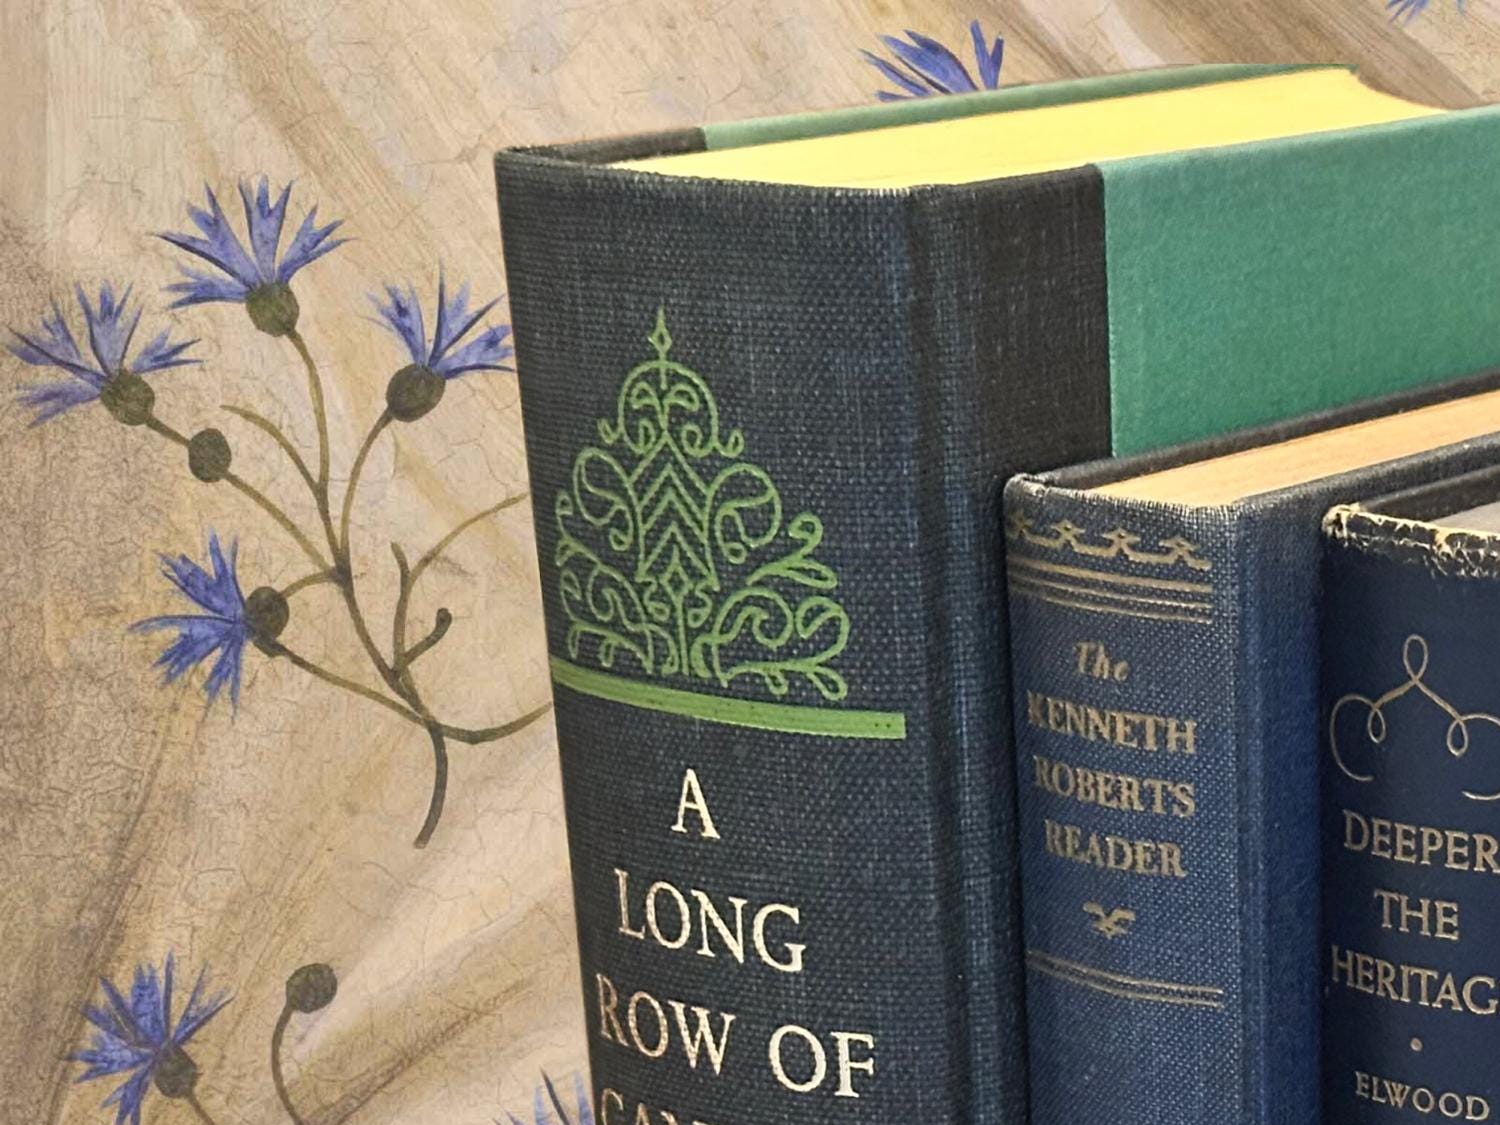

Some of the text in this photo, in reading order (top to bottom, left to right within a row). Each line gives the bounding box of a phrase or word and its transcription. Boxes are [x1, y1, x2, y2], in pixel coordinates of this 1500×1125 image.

[1073, 641, 1131, 682] The
[1027, 689, 1197, 754] KENNETH
[671, 768, 720, 839] A
[1033, 755, 1195, 818] ROBERTS
[1045, 819, 1189, 879] READER
[613, 868, 806, 973] LONG
[1374, 889, 1460, 941] THE
[596, 973, 875, 1098] ROW OF
[1355, 1070, 1490, 1121] ELWOOD
